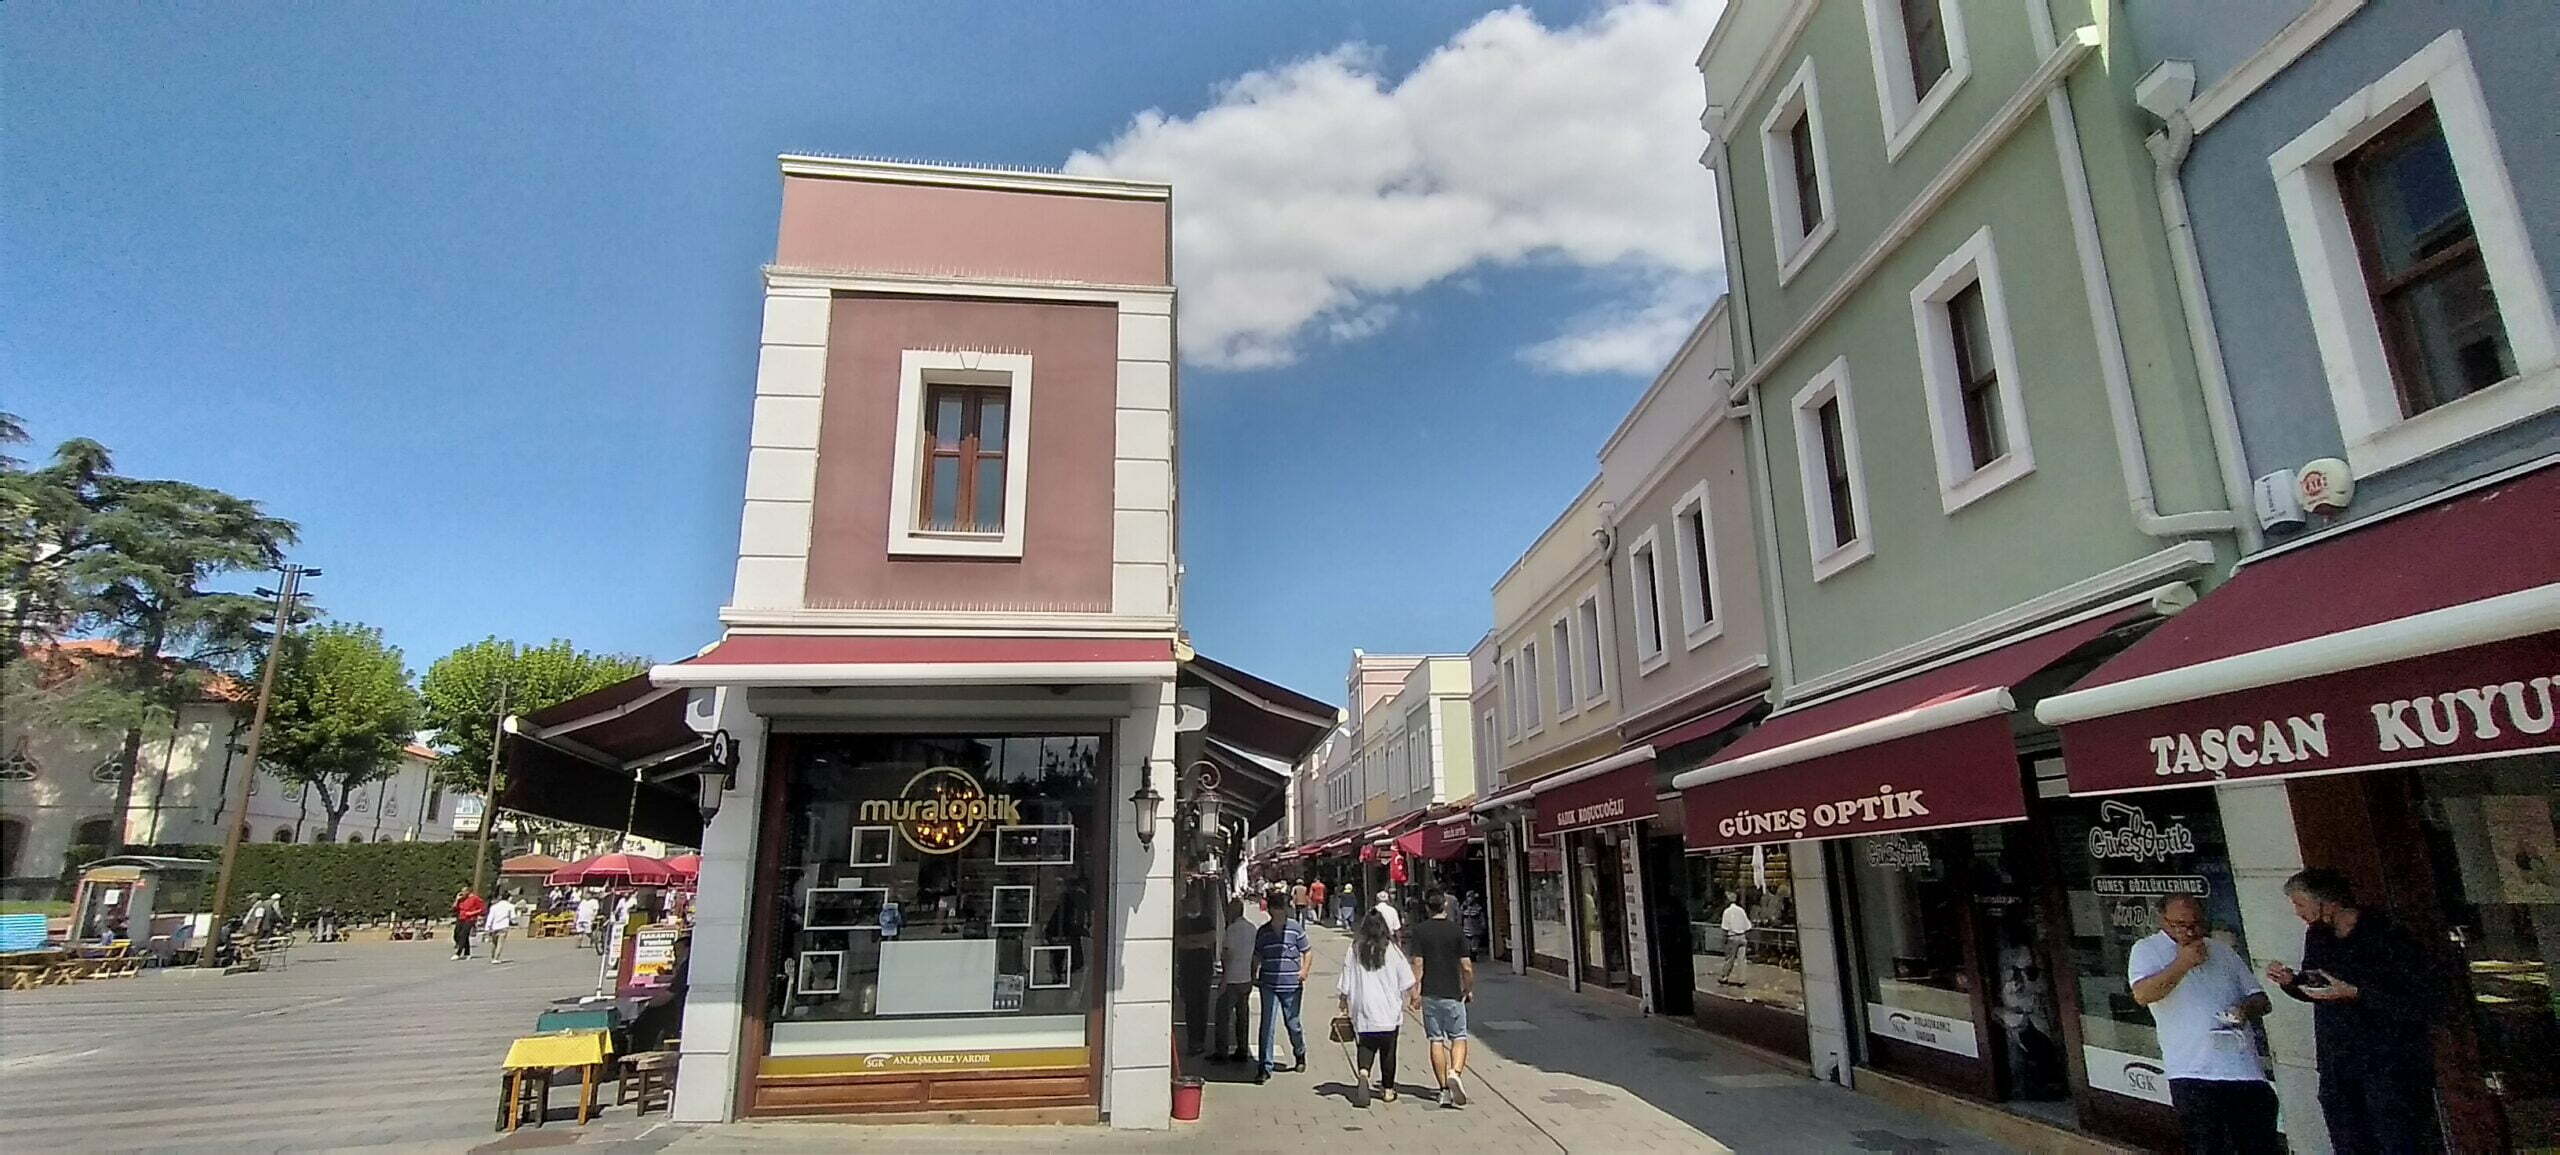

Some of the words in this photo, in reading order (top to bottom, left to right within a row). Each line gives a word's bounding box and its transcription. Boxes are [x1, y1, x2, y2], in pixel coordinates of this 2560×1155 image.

[2150, 713, 2330, 779] TAŞCAN
[2370, 676, 2560, 752] KUYU
[860, 795, 1022, 827] muratoptik
[1719, 808, 1807, 839] GÜNEŞ
[1813, 784, 1929, 827] OPTİK
[893, 1055, 954, 1066] ANLAŞMAMIZ
[956, 1054, 991, 1063] VARDIR
[2128, 1071, 2157, 1091] SGK
